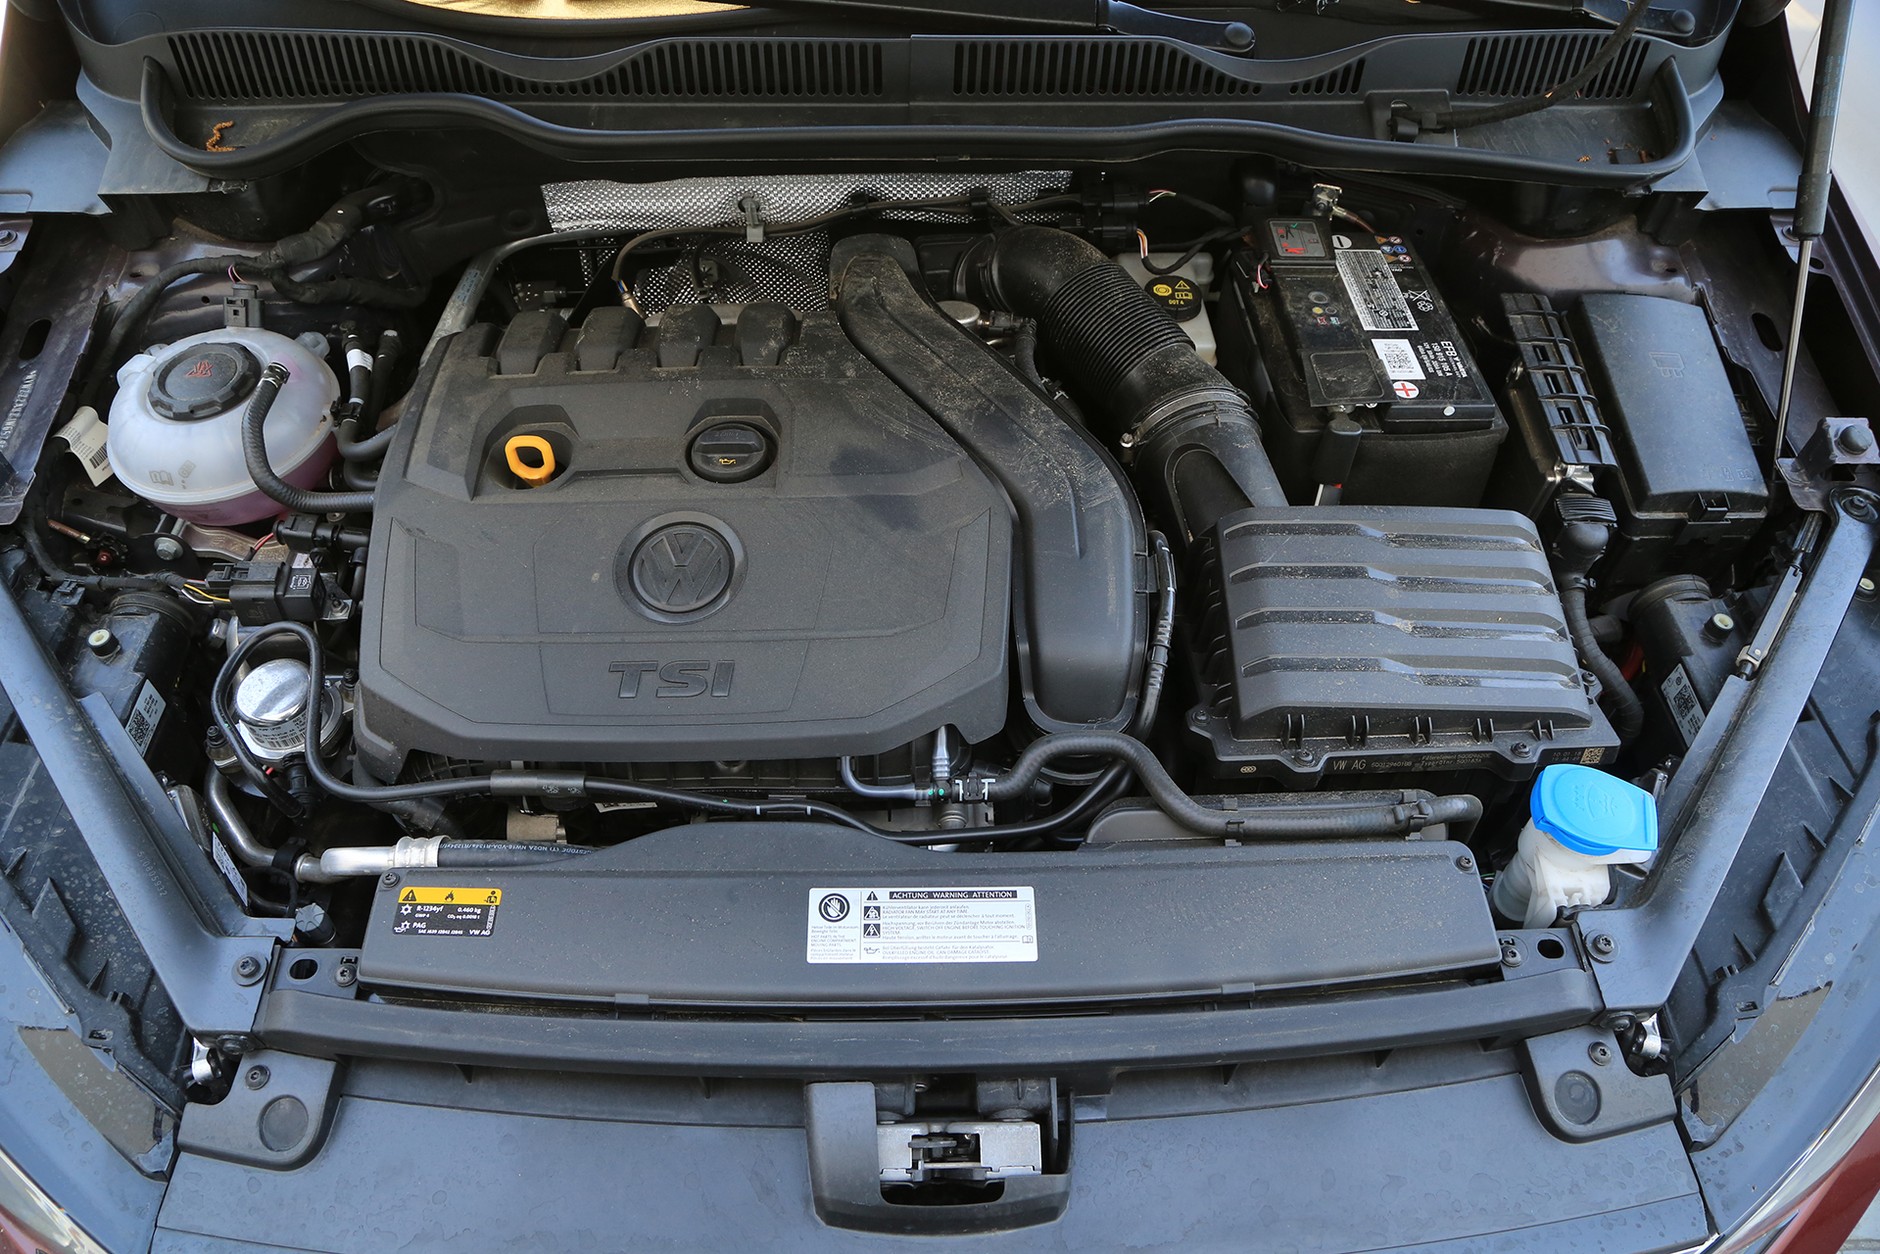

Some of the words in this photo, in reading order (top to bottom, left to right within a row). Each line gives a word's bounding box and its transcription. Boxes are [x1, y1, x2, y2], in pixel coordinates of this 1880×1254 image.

[1440, 341, 1458, 356] EFB
[608, 660, 735, 698] TSI
[1333, 760, 1348, 770] VW
[1351, 759, 1366, 770] AG
[416, 905, 444, 913] R-1234yf
